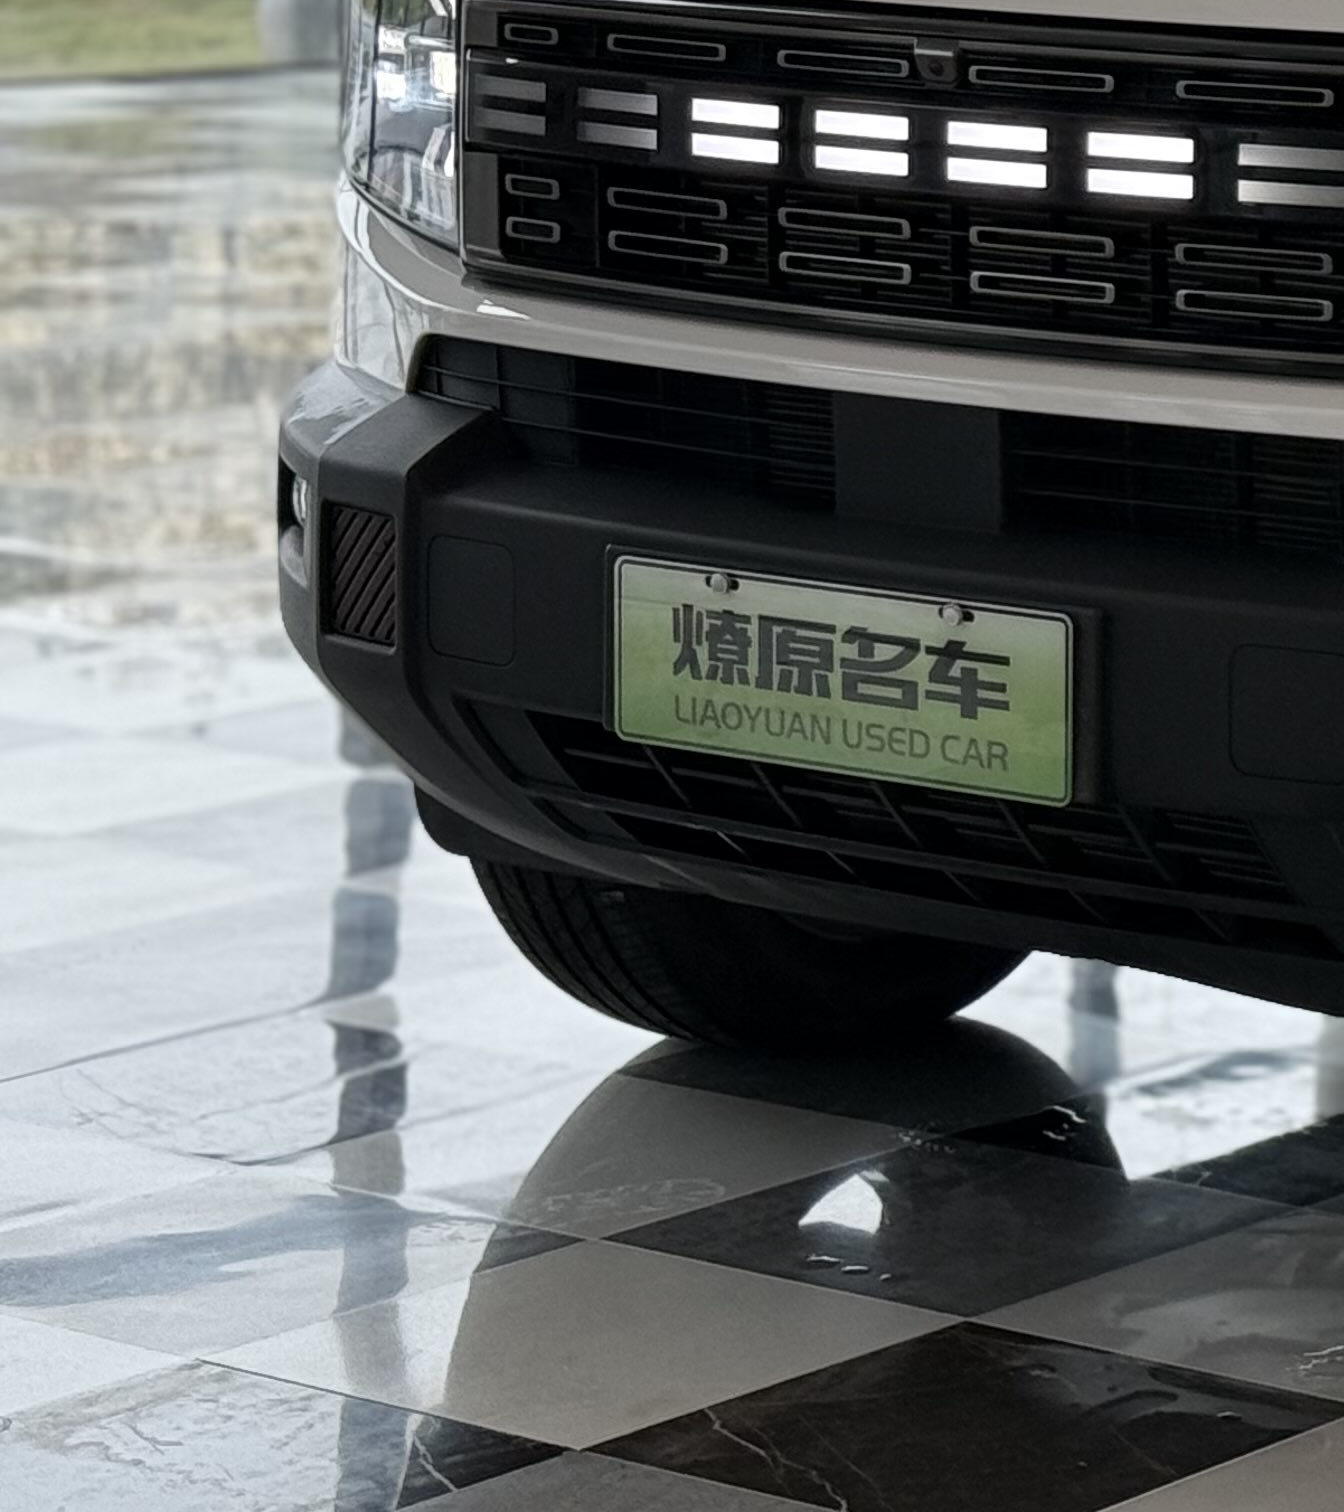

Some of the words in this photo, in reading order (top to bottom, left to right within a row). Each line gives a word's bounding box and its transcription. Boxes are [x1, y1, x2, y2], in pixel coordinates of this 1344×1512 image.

[672, 603, 1011, 720] 燎原名车
[674, 695, 832, 745] LIAOYUAN
[842, 719, 930, 758] USED
[941, 734, 1009, 772] CAR
